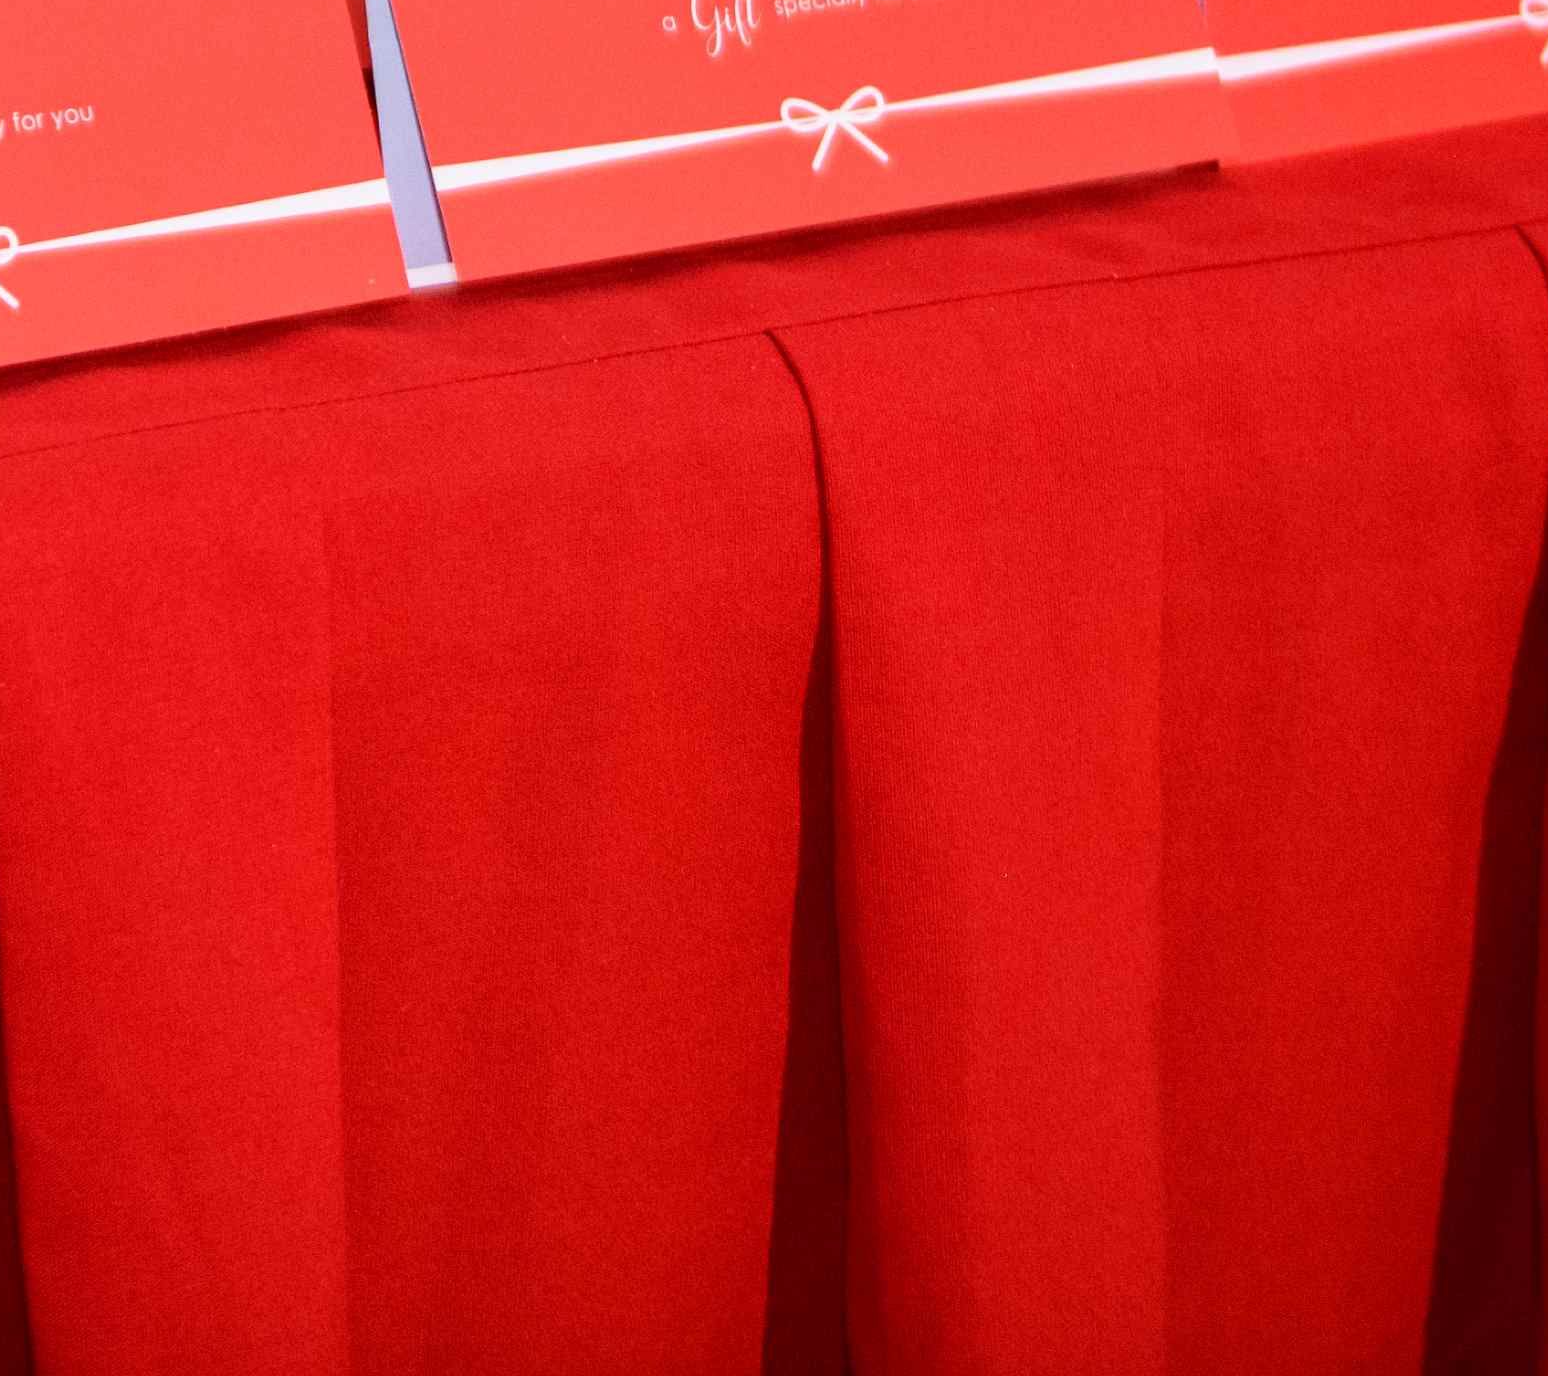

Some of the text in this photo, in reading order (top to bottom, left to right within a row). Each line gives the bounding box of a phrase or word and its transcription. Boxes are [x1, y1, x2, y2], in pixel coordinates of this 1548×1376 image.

[662, 14, 678, 32] a
[12, 110, 45, 133] for
[51, 104, 96, 132] you
